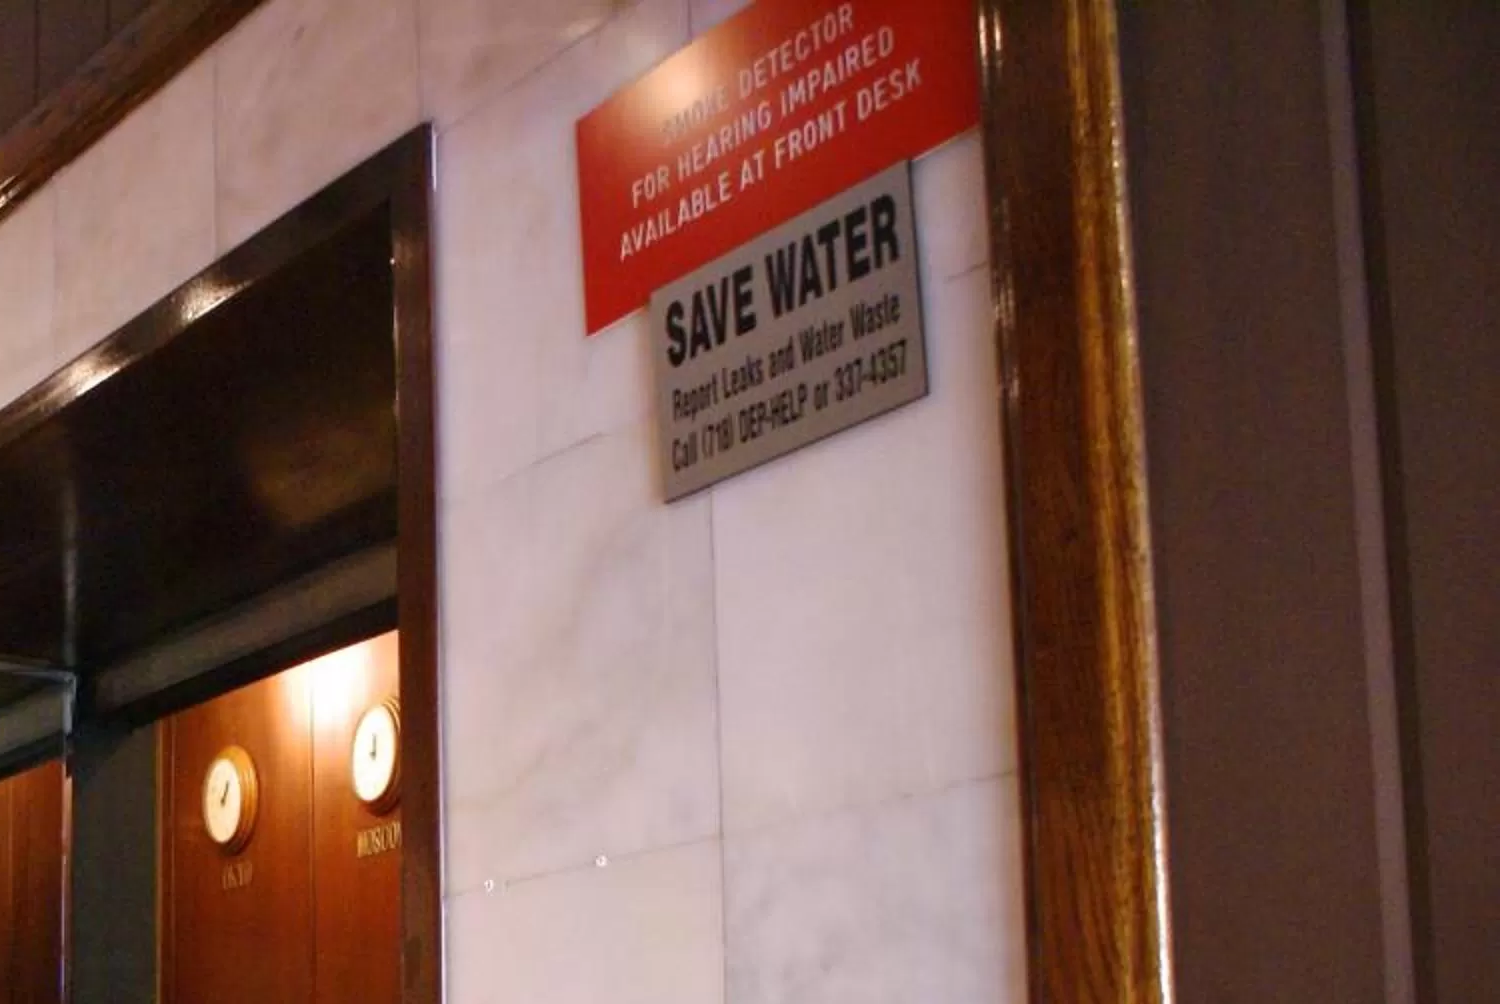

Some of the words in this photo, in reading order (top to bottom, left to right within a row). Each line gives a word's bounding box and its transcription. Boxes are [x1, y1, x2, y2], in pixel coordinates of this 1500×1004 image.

[632, 165, 670, 208] FOR
[677, 102, 772, 182] HEARING
[780, 26, 895, 117] IMPAIRED
[739, 3, 853, 98] DETECTOR
[620, 171, 732, 261] AVAILABLE
[740, 150, 766, 190] AT
[774, 102, 847, 169] FRONT
[857, 58, 922, 122] DESK
[666, 264, 757, 368] SAVE
[765, 194, 899, 318] WATER
[672, 373, 718, 421] Report
[722, 356, 764, 398] Leaks
[769, 336, 794, 378] and
[799, 319, 845, 363] Water
[850, 294, 900, 340] Waste
[672, 431, 697, 472] Call
[739, 383, 807, 442] DEP-HELP
[813, 380, 830, 411] or
